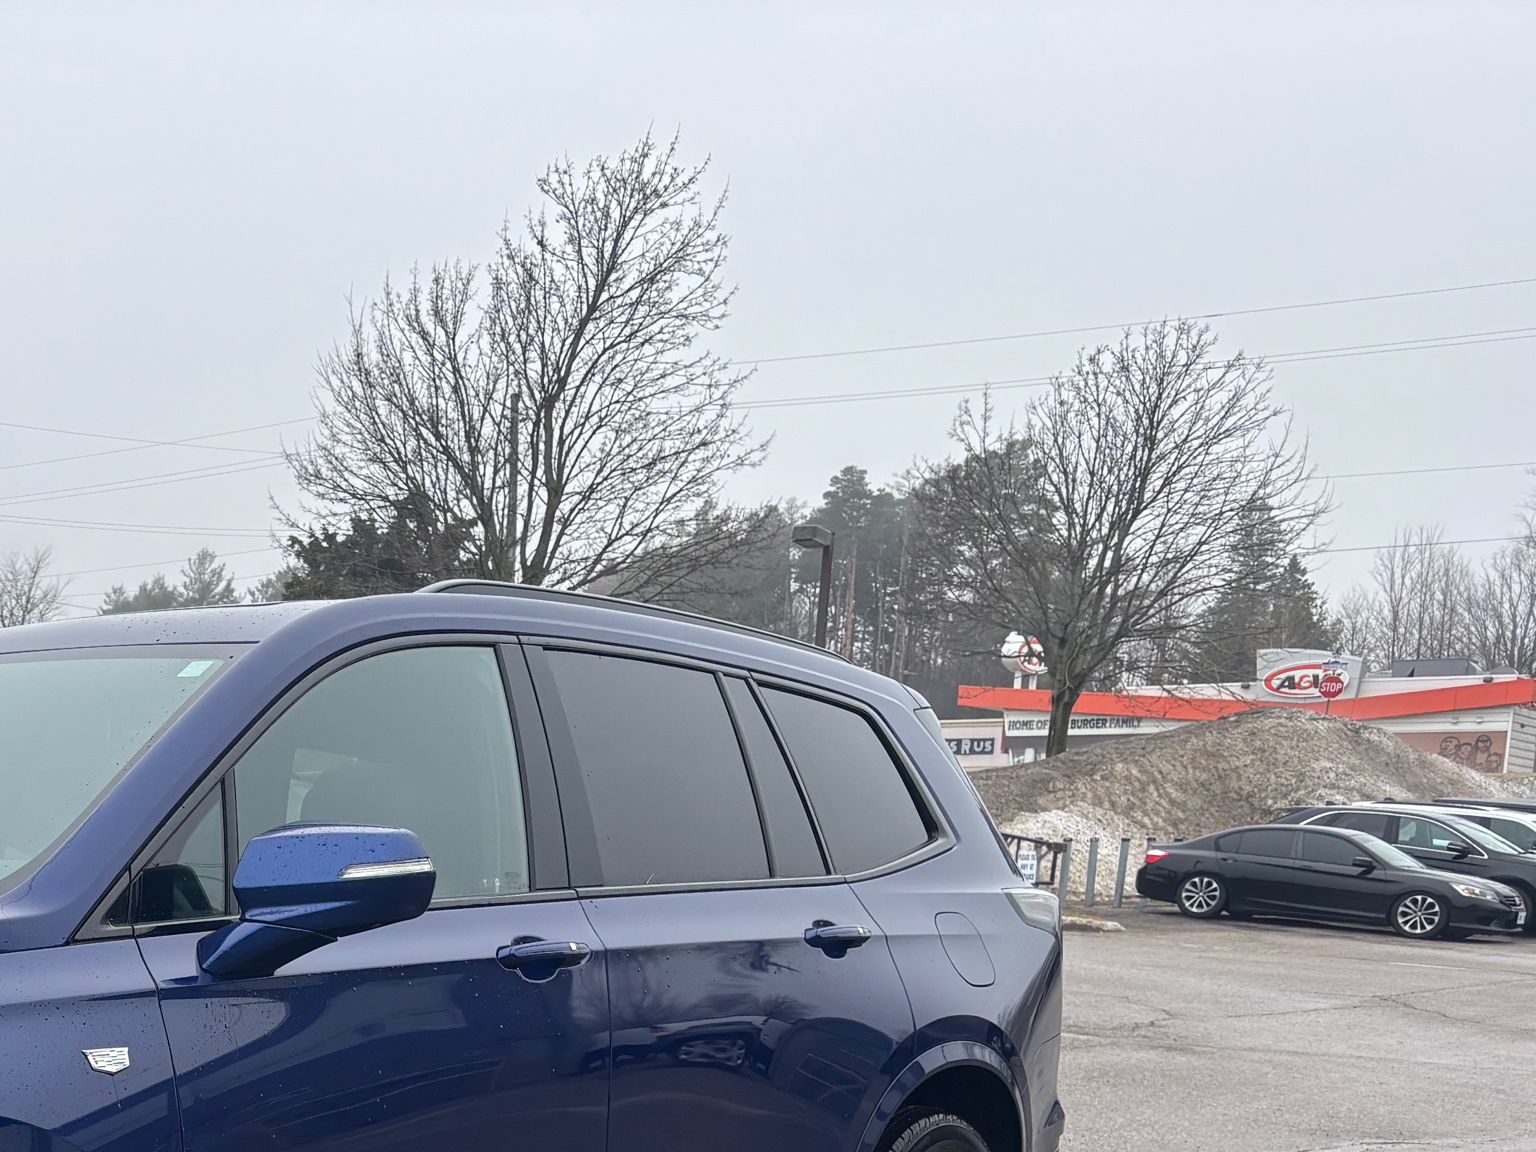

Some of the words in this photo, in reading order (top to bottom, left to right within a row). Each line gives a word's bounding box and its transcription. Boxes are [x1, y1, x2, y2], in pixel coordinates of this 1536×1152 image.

[1321, 683, 1342, 692] STOP
[1008, 720, 1035, 730] HOME
[1036, 720, 1049, 729] OF
[1070, 718, 1107, 729] BURGER
[1109, 717, 1141, 728] FAMILY
[961, 738, 971, 754] R
[973, 740, 992, 751] US
